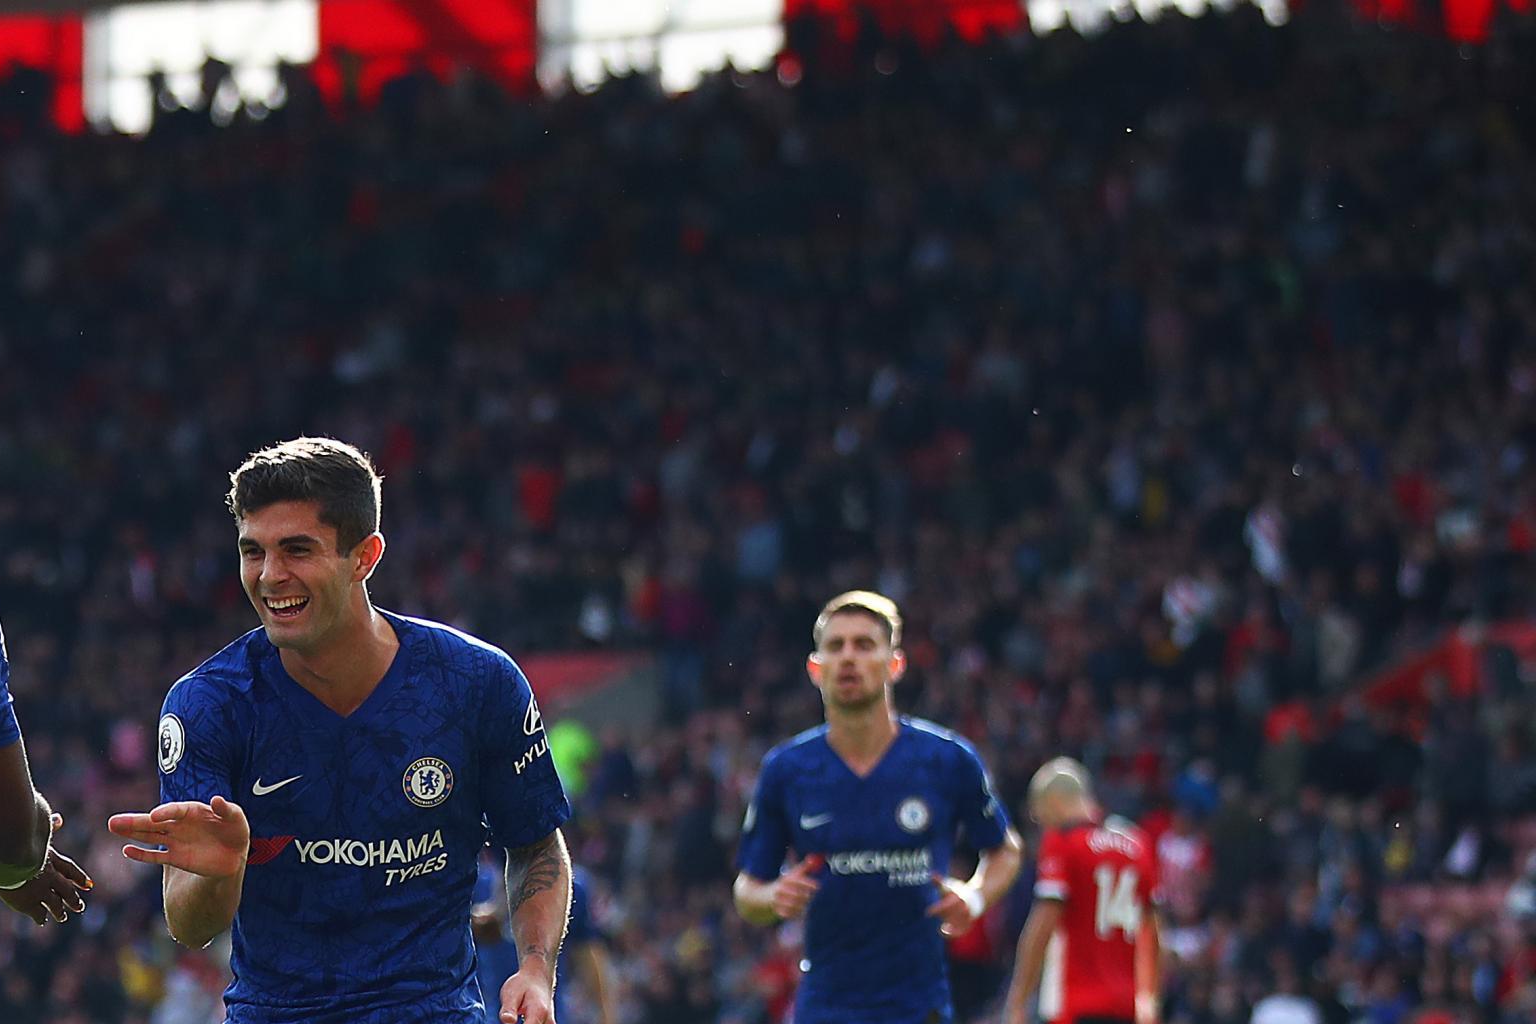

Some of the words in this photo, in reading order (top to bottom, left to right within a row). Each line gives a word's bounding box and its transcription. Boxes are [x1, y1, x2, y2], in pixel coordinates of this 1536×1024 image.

[411, 759, 445, 771] CHELSEA
[294, 829, 444, 867] YOKOHAMA
[826, 849, 931, 876] YOKOHAMA
[384, 852, 448, 886] TYRES
[1093, 862, 1143, 942] 14
